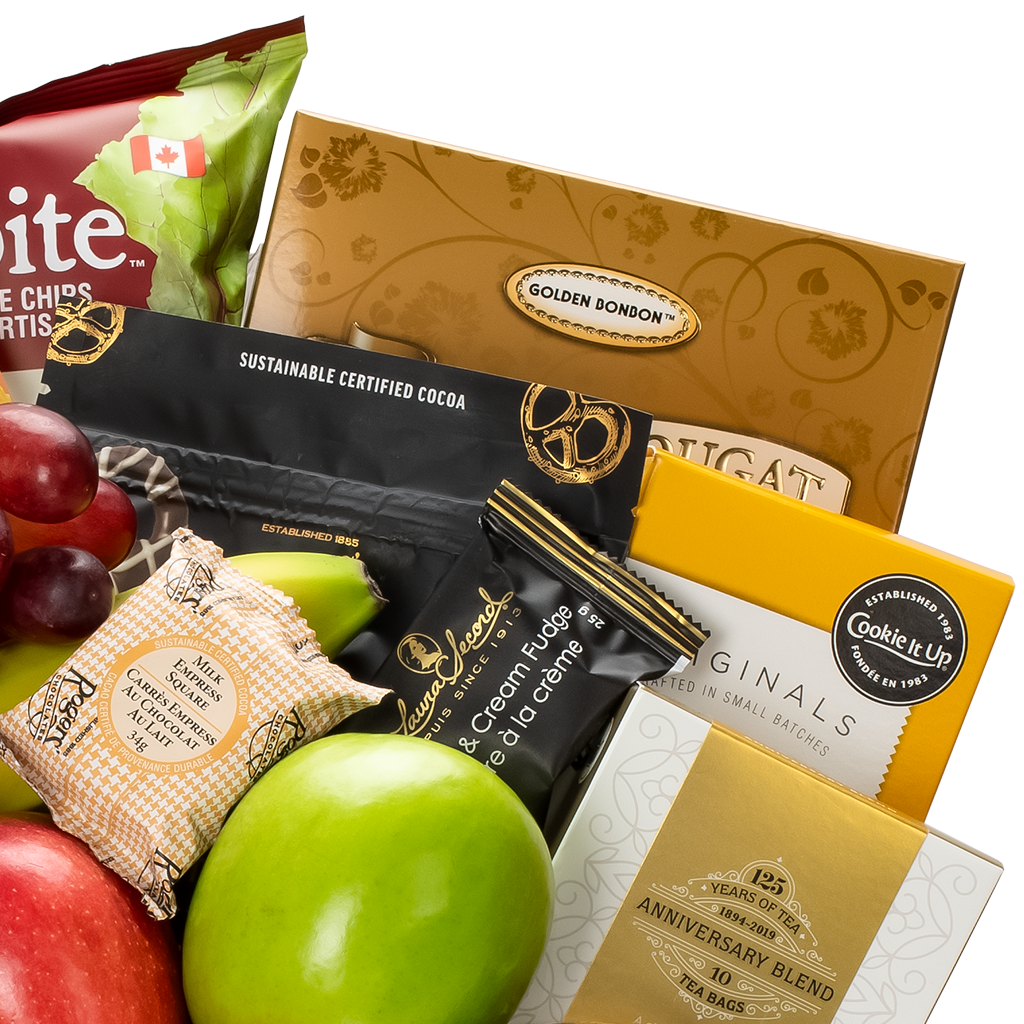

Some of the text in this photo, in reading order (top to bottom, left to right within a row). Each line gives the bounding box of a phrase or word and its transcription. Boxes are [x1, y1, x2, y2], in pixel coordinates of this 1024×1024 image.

[528, 283, 592, 309] GOLDEN
[239, 351, 466, 411] SUSTAINABLE CERTIFIED COCOA
[261, 523, 360, 548] ESTABLISHED 1885
[434, 586, 514, 685] Second
[577, 605, 606, 629] 25 g
[846, 611, 953, 669] Cookie It Up
[864, 590, 954, 641] ESTABLISHED 1983
[154, 637, 249, 716] SUSTAINABLE CERTIFIED COCOA
[424, 607, 523, 741] PUIS SINCE 1913
[458, 737, 481, 754] &
[471, 661, 531, 734] Cream
[520, 605, 573, 662] Fudge
[497, 640, 584, 746] à la crème
[692, 650, 857, 737] IGINALS
[851, 644, 928, 689] FONDÉE EN 1983
[99, 672, 214, 773] CACAO CERTIFIÉ DE PROVENANCE DURABLE
[127, 730, 149, 753] 34g
[701, 684, 717, 699] IN
[723, 691, 767, 720] SMALL
[772, 713, 830, 758] BATCHES
[711, 882, 801, 936] YEARS OF TEA
[750, 868, 787, 896] 125
[636, 896, 835, 1002] ANNIVERSARY BLEND
[709, 967, 732, 986] 10
[678, 973, 745, 1014] TEA BAGS
